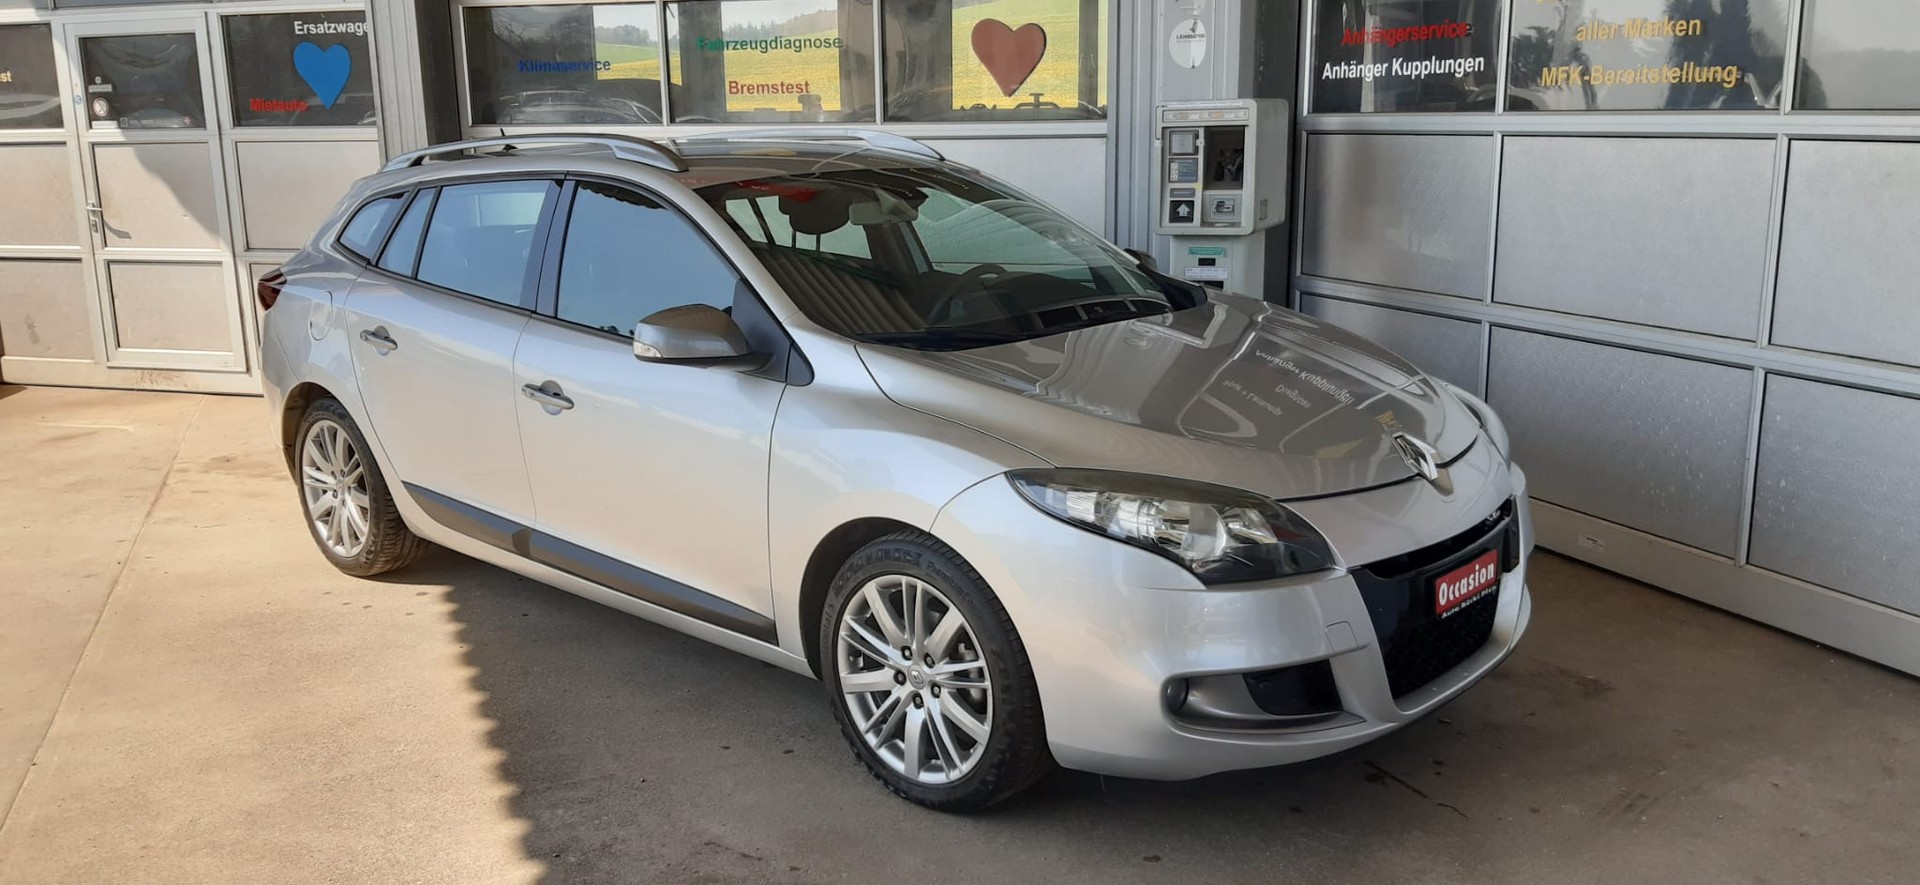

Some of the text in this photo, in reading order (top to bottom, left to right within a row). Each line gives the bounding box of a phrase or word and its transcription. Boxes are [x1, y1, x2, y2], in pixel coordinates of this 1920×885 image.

[1341, 22, 1467, 46] Anhängerservice
[1577, 16, 1702, 41] aller Marken
[695, 36, 844, 54] Fahrzeugdiagnose
[517, 58, 611, 74] Klimaservice
[1322, 54, 1485, 81] Anhänger Kupplungen
[1540, 61, 1738, 88] MFK-Bereitstellung
[728, 80, 811, 96] Bremstest
[1439, 563, 1495, 605] Occasion
[1442, 606, 1460, 619] Auto
